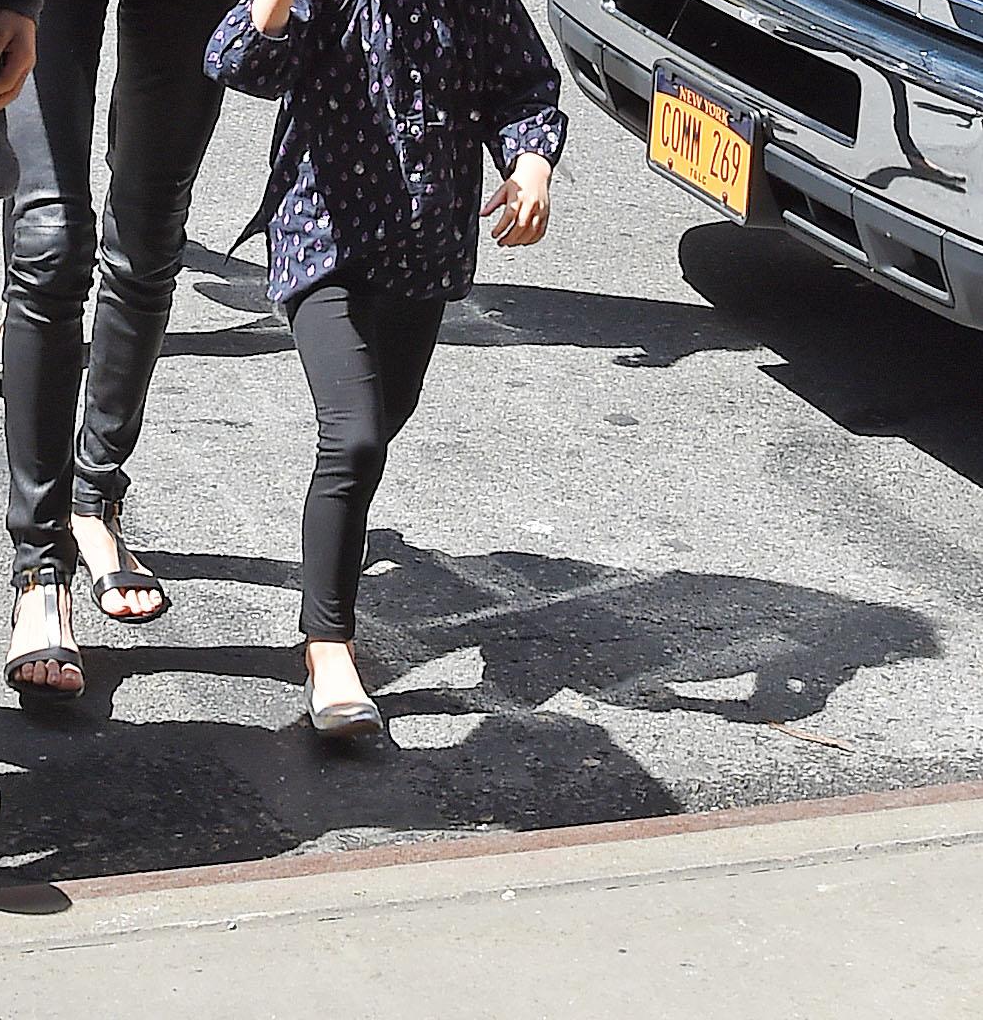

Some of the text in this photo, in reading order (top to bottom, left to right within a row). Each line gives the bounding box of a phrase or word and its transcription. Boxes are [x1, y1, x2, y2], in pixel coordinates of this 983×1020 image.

[679, 85, 730, 127] NEW YORK
[661, 102, 741, 187] COMM 269
